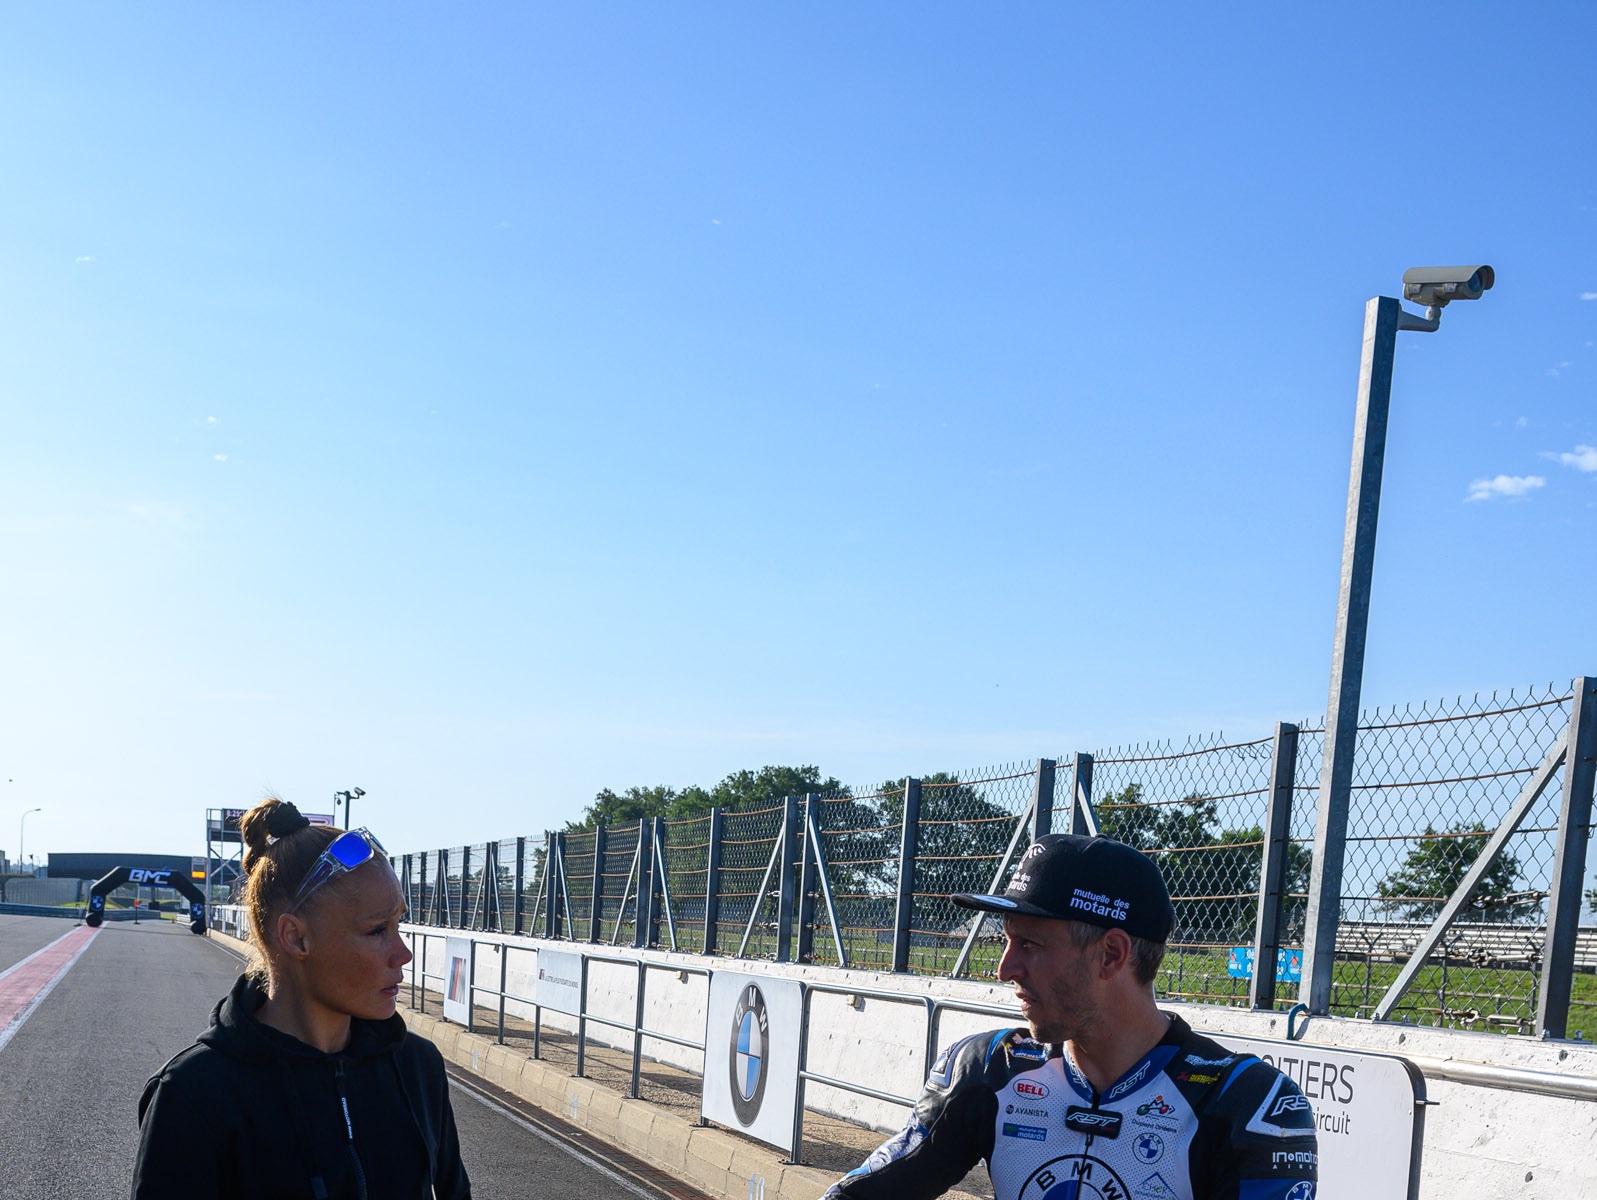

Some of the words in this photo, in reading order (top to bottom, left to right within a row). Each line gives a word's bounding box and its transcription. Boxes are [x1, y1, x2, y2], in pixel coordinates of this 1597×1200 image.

[128, 869, 171, 885] BMC
[1070, 895, 1127, 921] motards
[1073, 888, 1110, 904] mutuelle
[1114, 898, 1130, 910] des
[735, 986, 768, 1033] BMW
[1017, 1083, 1044, 1097] BELL
[1109, 1060, 1151, 1099] RST
[1271, 1095, 1310, 1116] RS
[1067, 1111, 1120, 1127] RST
[1313, 1106, 1351, 1136] ircuit
